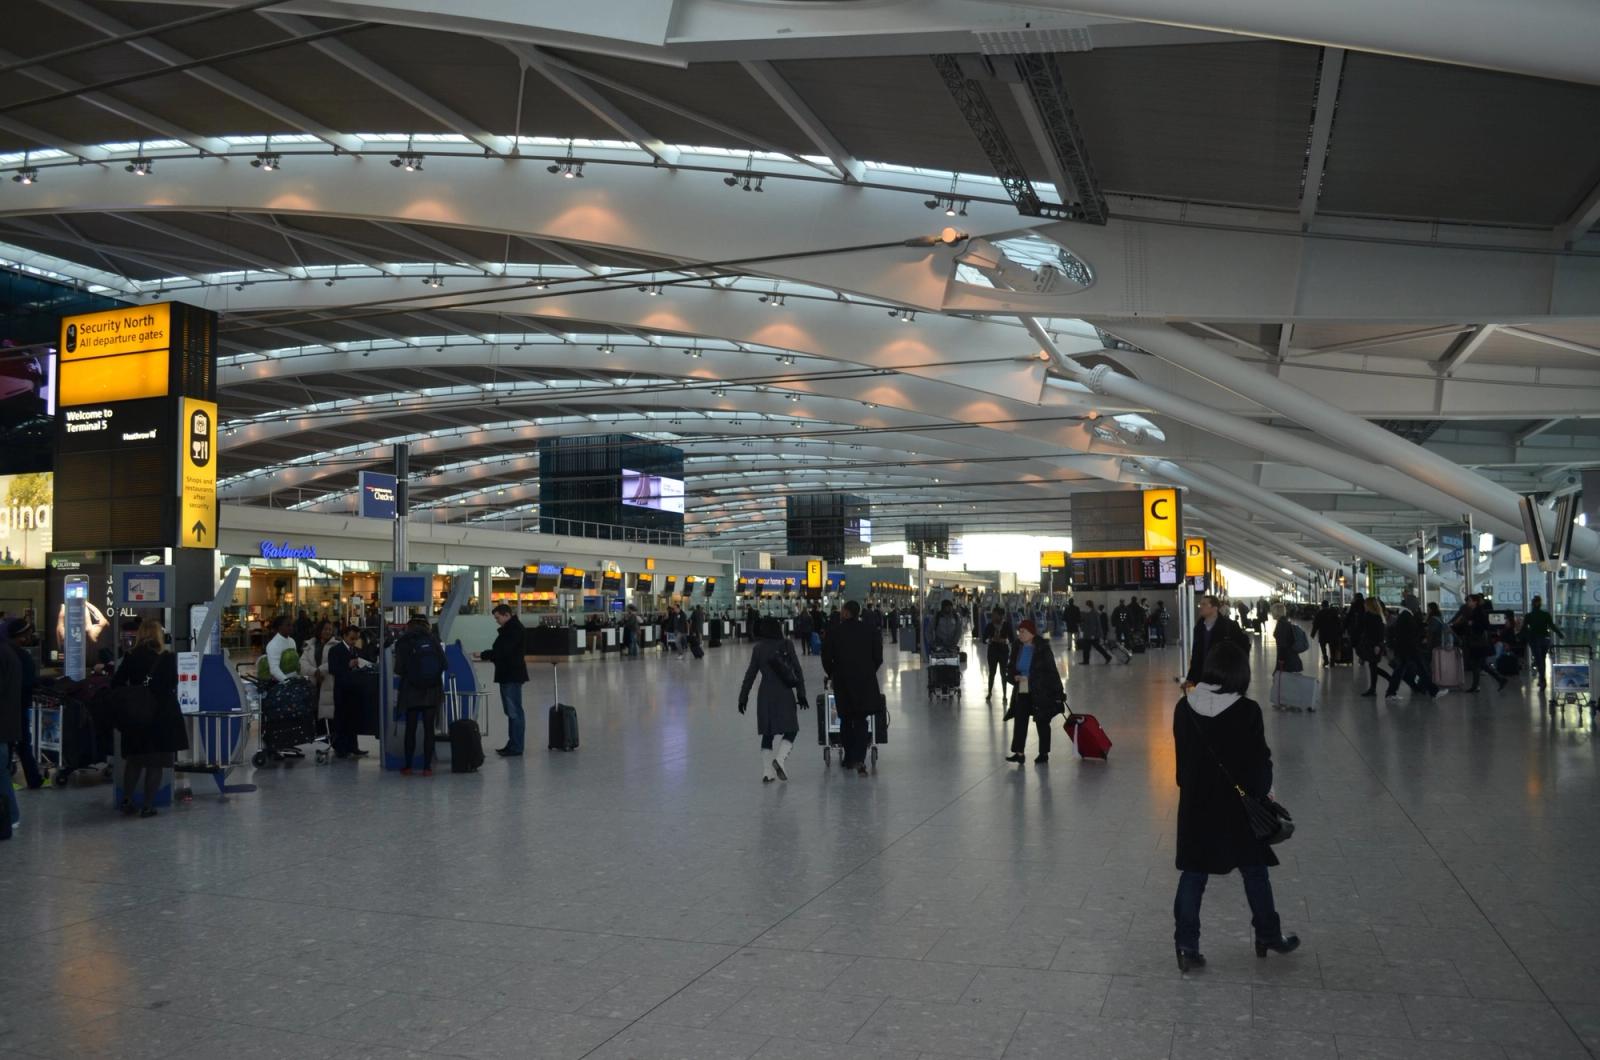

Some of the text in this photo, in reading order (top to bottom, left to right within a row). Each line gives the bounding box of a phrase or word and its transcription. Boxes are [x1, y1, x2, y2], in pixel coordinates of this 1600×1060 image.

[80, 314, 154, 335] Security North
[80, 330, 163, 348] All departure gates
[66, 409, 113, 421] Welcome to
[66, 420, 108, 433] Terminal 5
[1151, 498, 1168, 520] C
[1189, 544, 1201, 557] D
[811, 564, 817, 574] E
